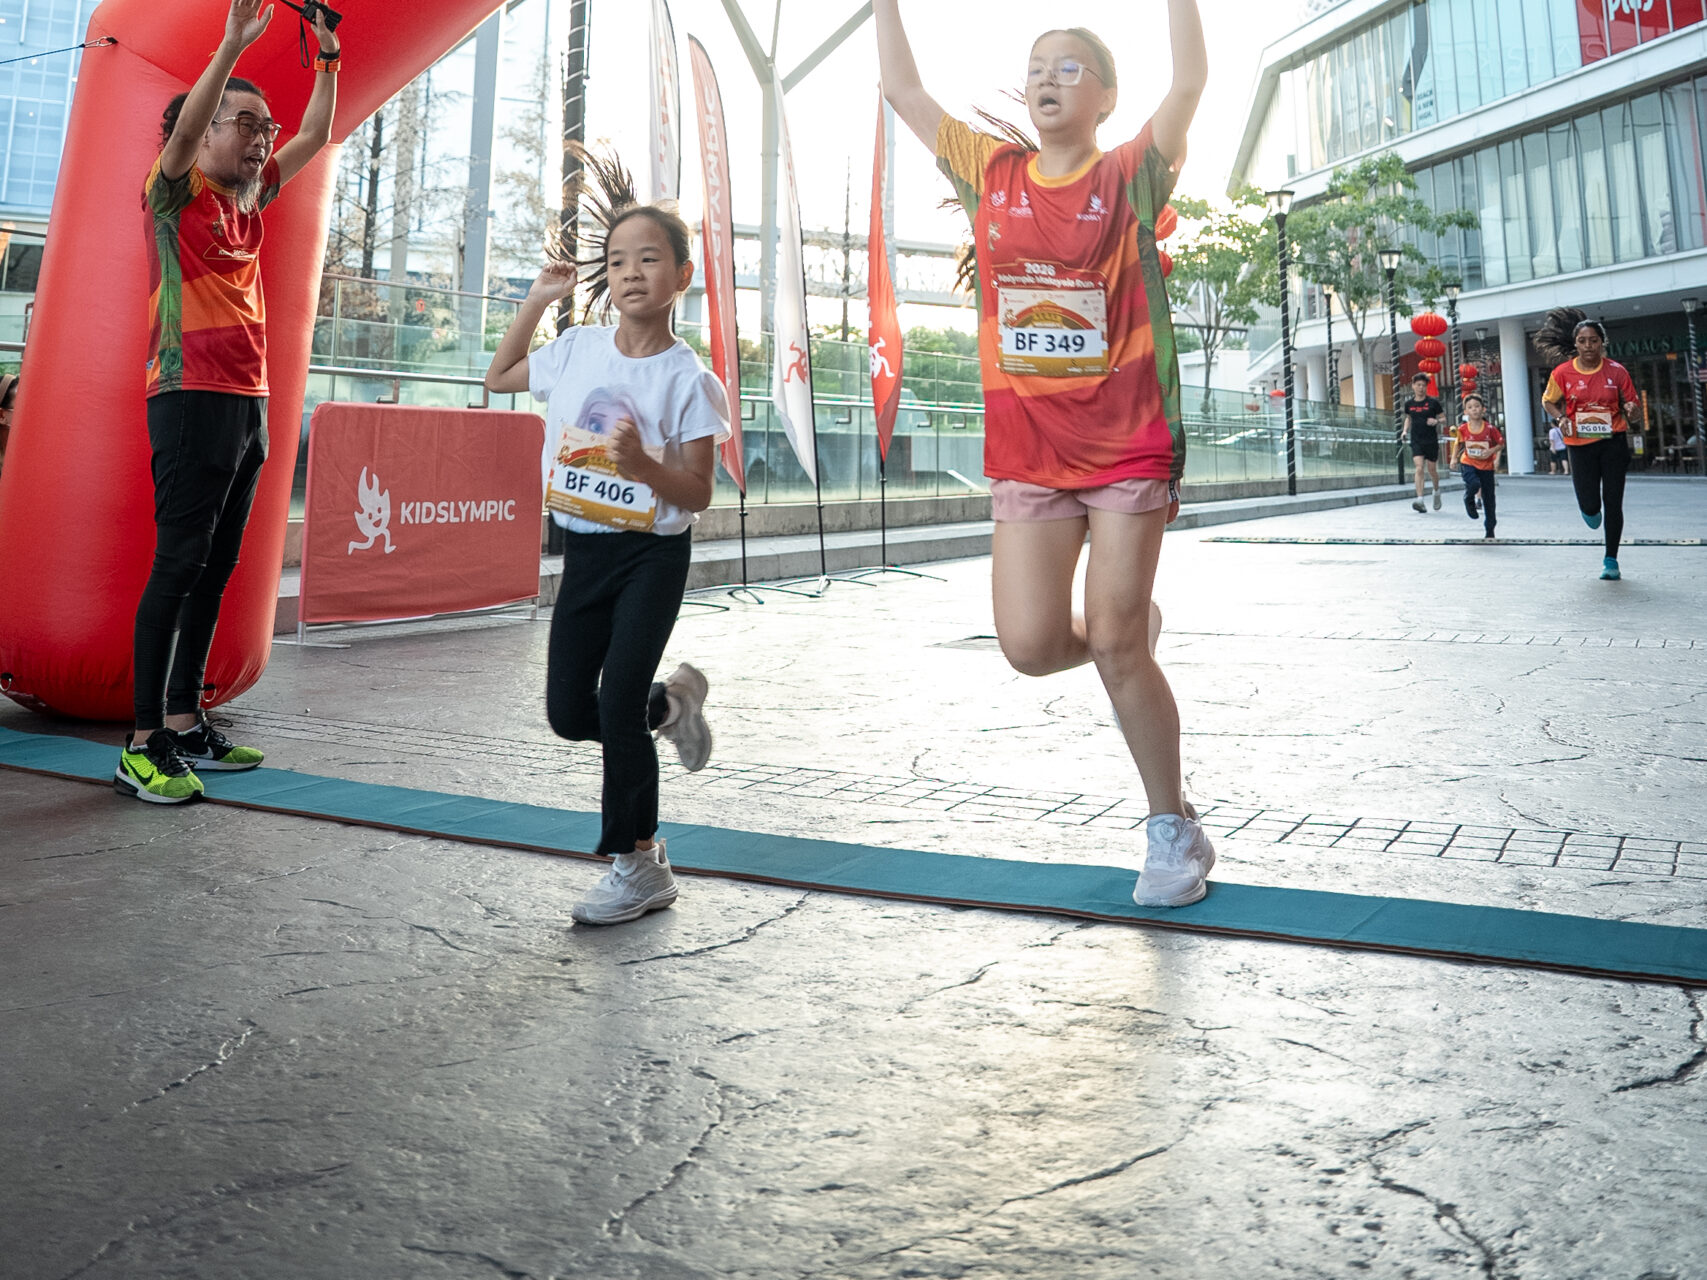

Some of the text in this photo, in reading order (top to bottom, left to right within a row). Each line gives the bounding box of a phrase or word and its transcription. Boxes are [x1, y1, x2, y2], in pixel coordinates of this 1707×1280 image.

[1015, 332, 1085, 353] BF 349
[565, 470, 590, 493] BF
[594, 480, 635, 505] 406
[400, 499, 516, 525] KIDSLYMPIC
